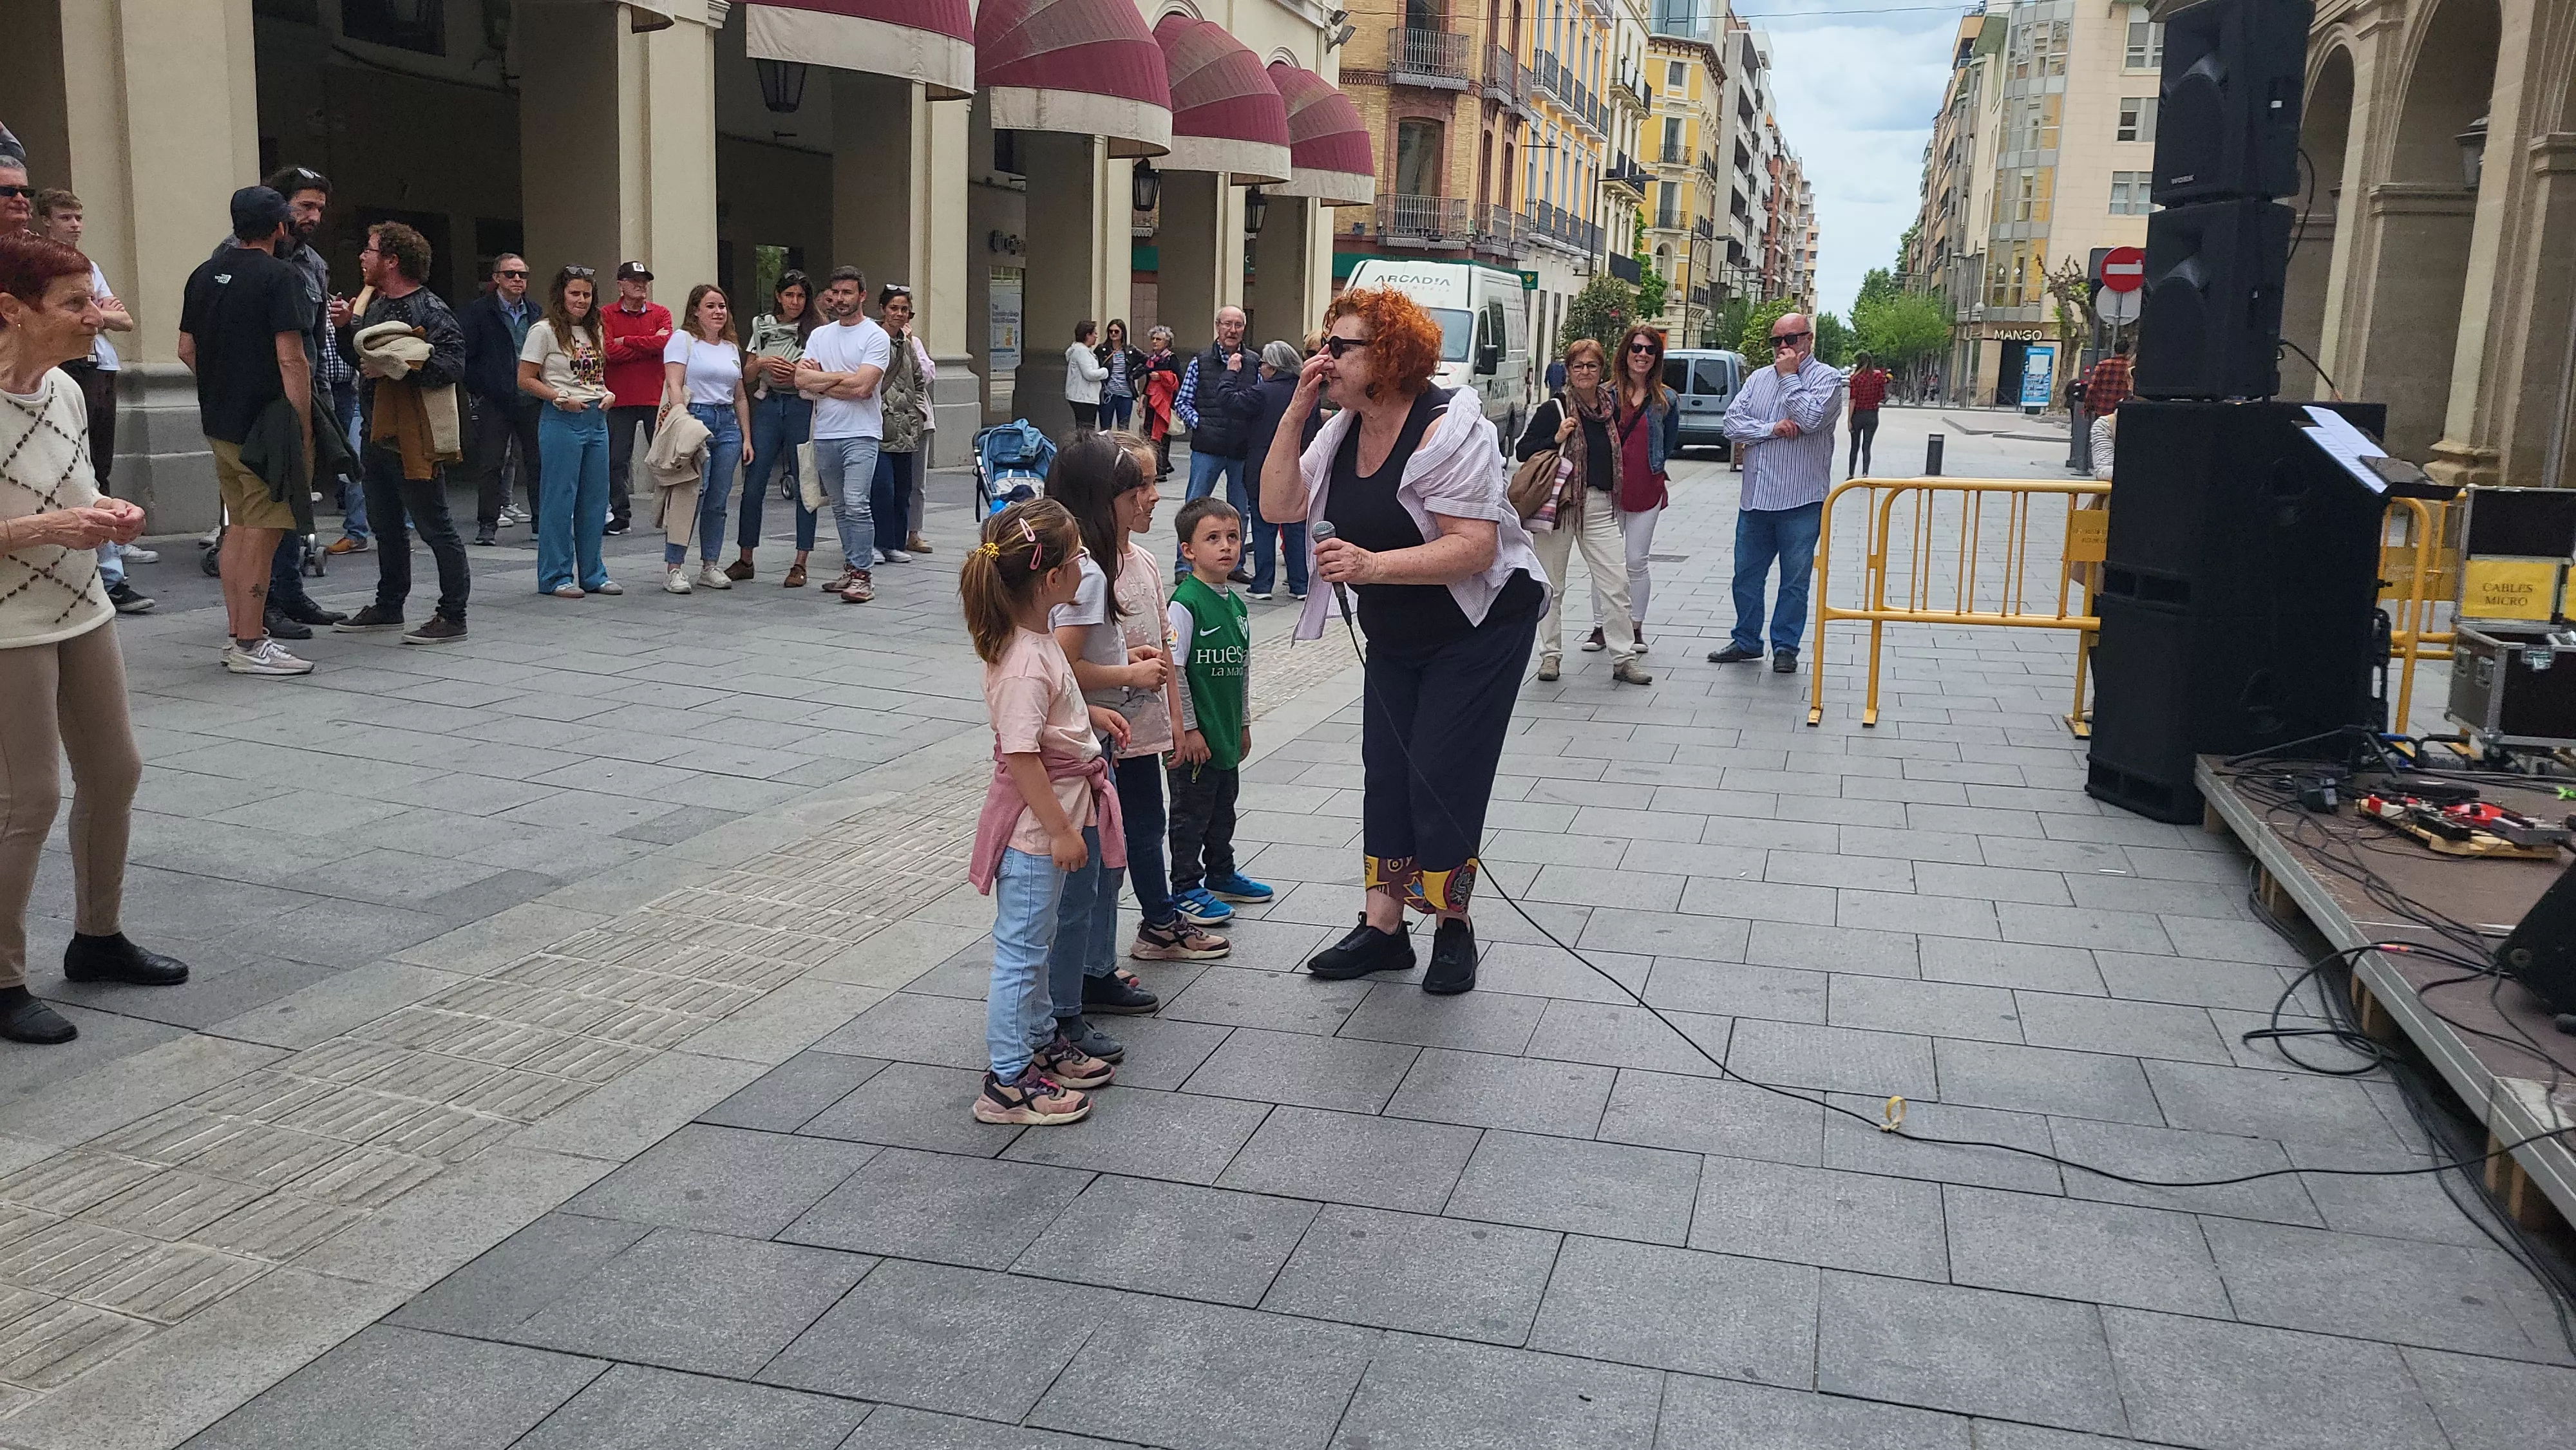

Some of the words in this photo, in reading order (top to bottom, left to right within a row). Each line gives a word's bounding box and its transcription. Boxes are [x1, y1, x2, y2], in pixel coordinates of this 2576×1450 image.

[1994, 329, 2043, 341] MANGO
[2483, 583, 2533, 593] CABLES
[2485, 596, 2528, 606] MICRO
